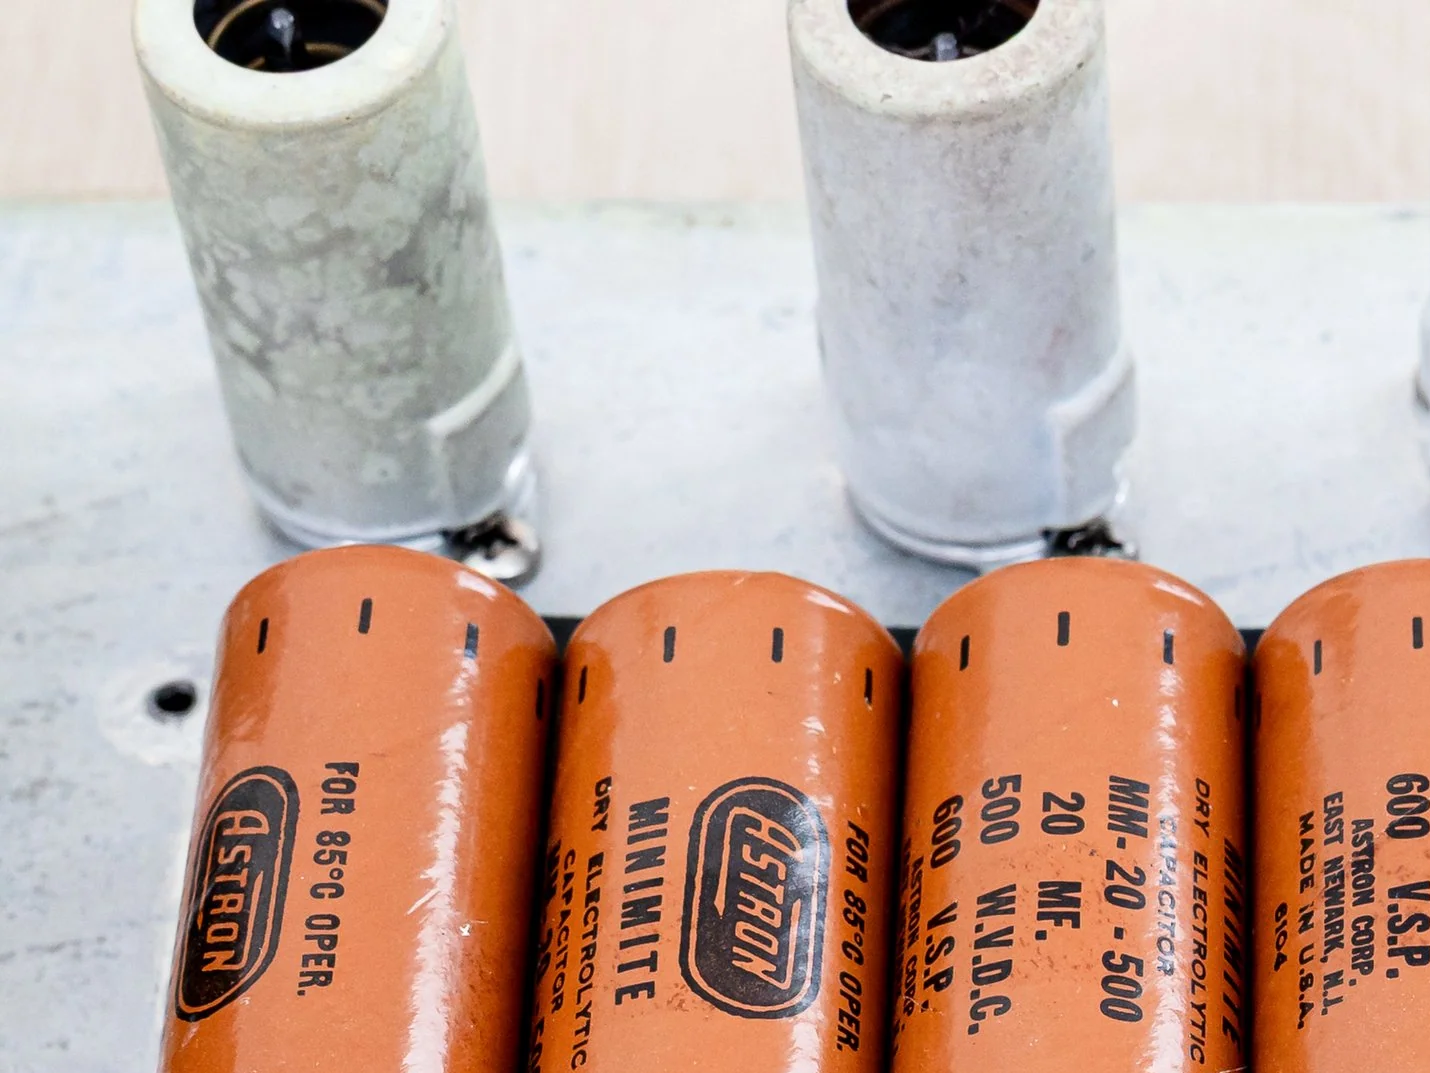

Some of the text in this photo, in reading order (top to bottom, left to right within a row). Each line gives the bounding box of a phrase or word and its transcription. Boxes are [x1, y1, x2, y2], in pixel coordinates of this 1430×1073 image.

[198, 809, 270, 972] ASTRON
[297, 762, 360, 996] FOR 85°C OPER.
[591, 776, 612, 832] DRY
[930, 794, 964, 869] 600
[1035, 792, 1085, 941] 20 MF.
[1194, 777, 1210, 837] DRY
[1385, 773, 1430, 840] 600
[550, 849, 576, 1014] CAPACITOR
[571, 852, 604, 1070] ELECTROLYTIC
[615, 797, 670, 1005] MINIMITE
[722, 806, 805, 990] ASTRON
[836, 821, 869, 1053] FOR 85°C OPER.
[907, 855, 924, 946] ASTRON
[967, 774, 1022, 1036] 500 W.V.D.C.
[1156, 814, 1177, 978] CAPACITOR
[1189, 850, 1208, 1065] ELECTROLYTIC
[1222, 838, 1242, 1054] MINIMITE
[1297, 810, 1314, 1030] MADE IN U.S.A.
[1319, 791, 1345, 1016] EAST NEWARK, N.J.
[1348, 818, 1374, 987] ASTRON CORP.
